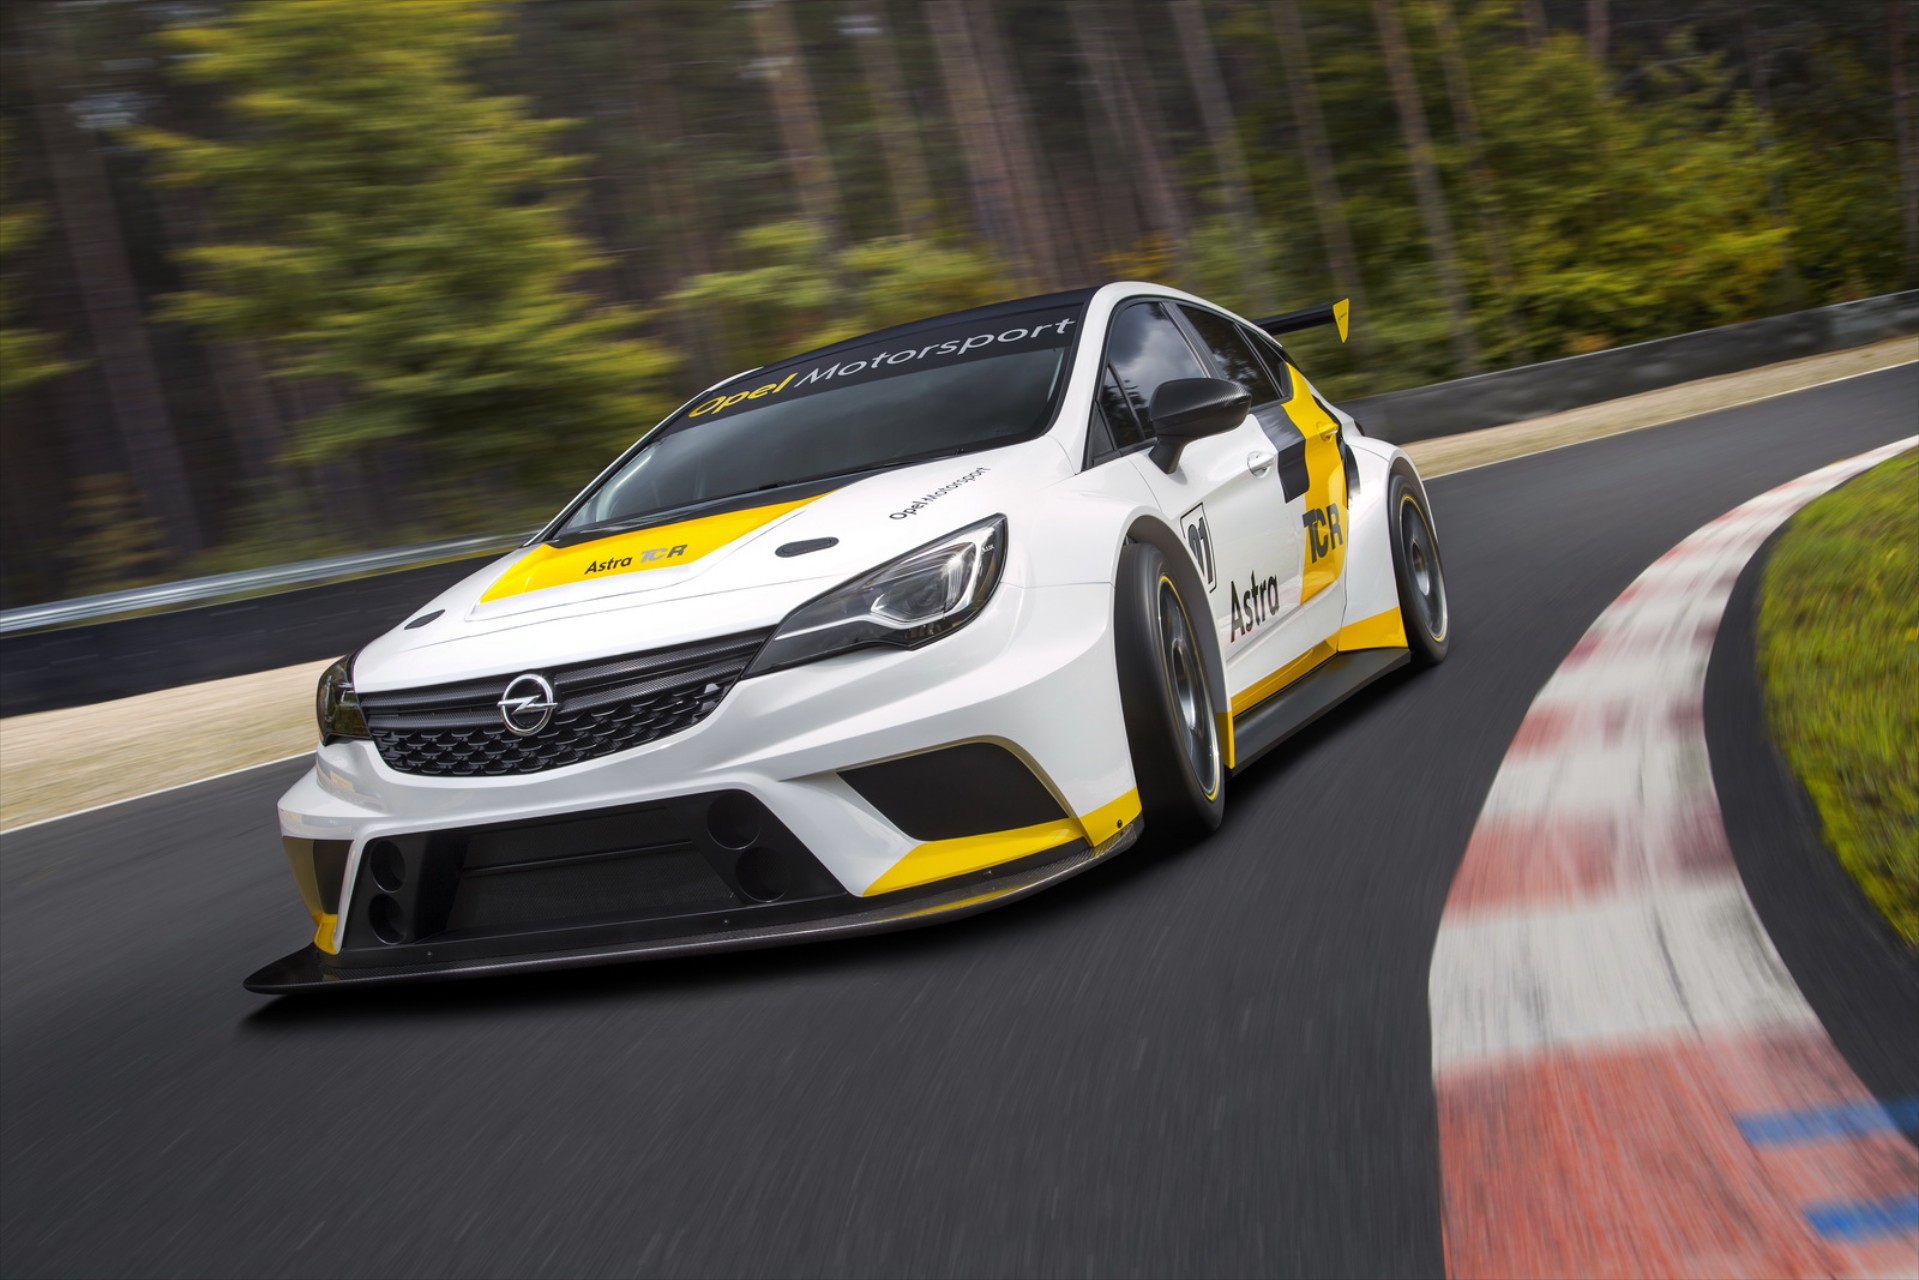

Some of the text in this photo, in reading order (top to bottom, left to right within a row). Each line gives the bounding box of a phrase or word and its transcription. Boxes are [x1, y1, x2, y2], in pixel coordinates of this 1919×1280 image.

[688, 318, 1076, 418] Opel Motorsport
[889, 467, 991, 520] Opel Motorsport
[584, 544, 688, 575] Astra TCR
[1302, 503, 1344, 564] TCR
[1230, 571, 1280, 643] Astra
